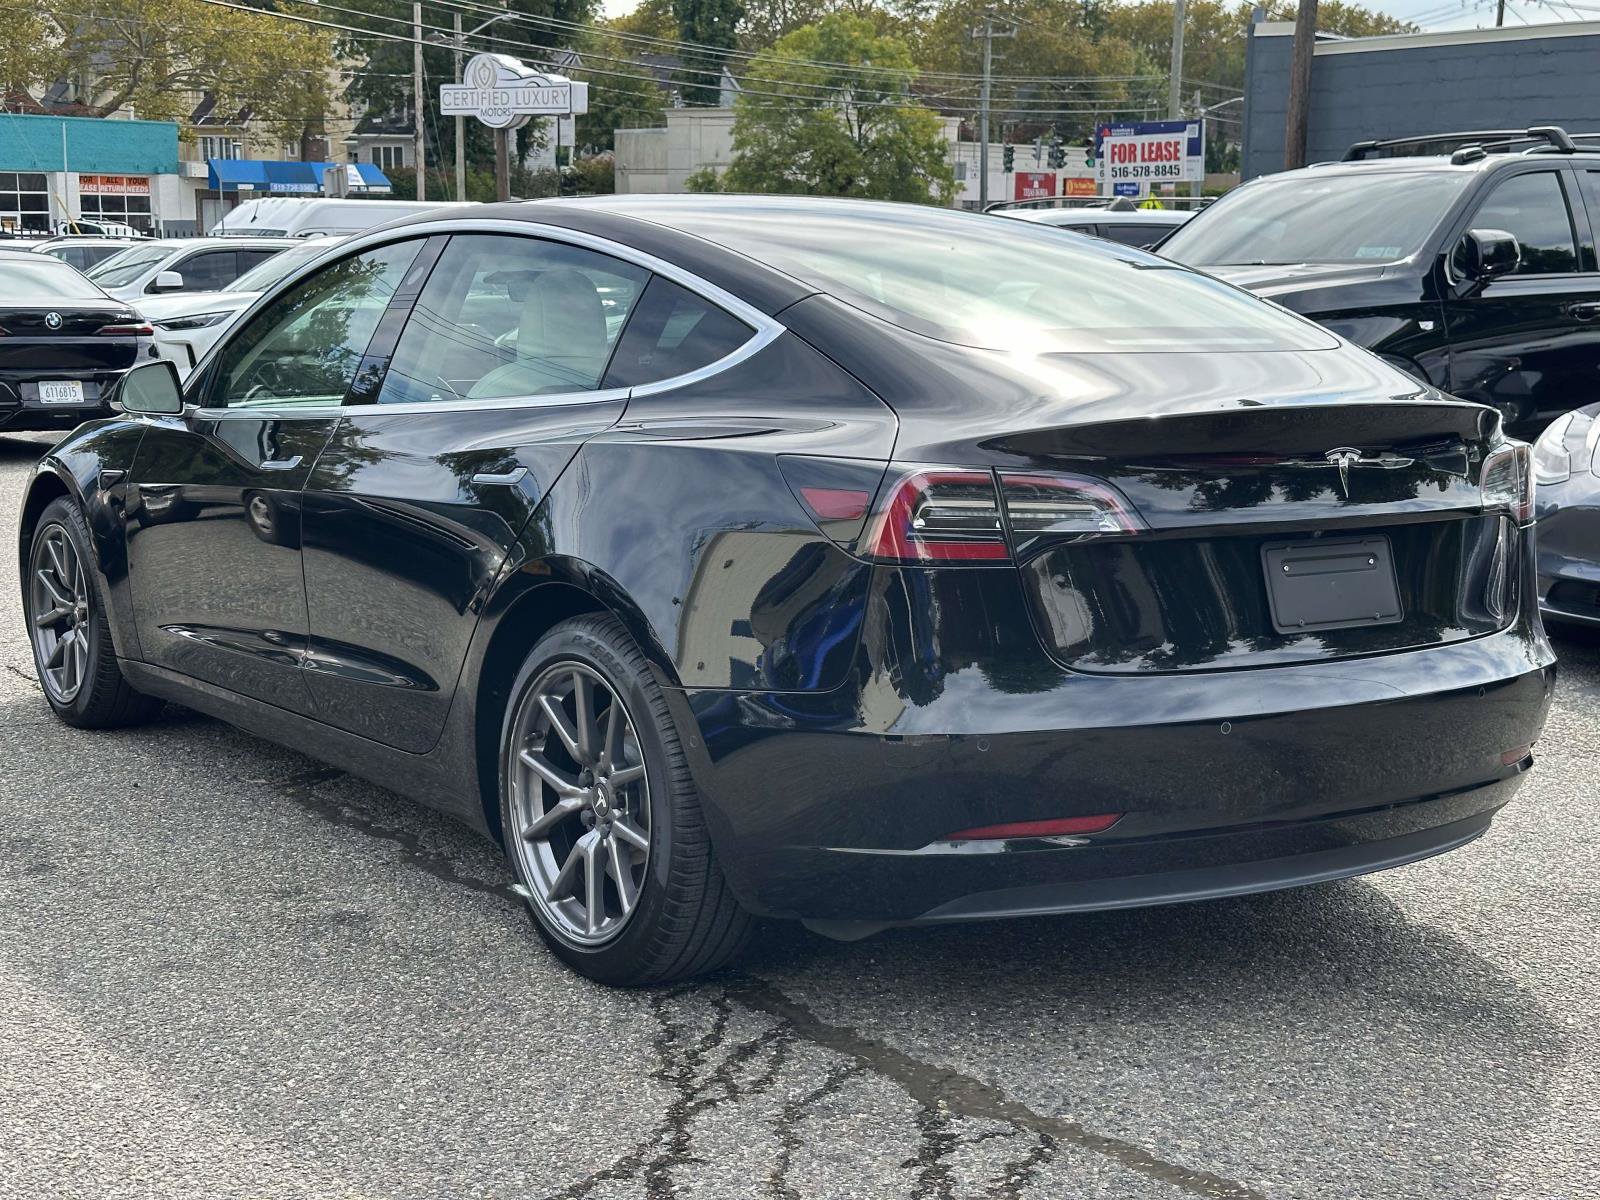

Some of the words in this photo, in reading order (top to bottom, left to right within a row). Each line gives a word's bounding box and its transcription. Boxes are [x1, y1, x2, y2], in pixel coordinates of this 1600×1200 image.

[442, 91, 510, 107] CERTIFIED
[515, 89, 569, 106] LUXURY
[480, 107, 512, 117] MOTORS
[1110, 143, 1137, 165] FOR
[1140, 141, 1181, 163] LEASE
[1111, 164, 1180, 178] 516-578-8845
[79, 176, 93, 184] FOR
[106, 176, 118, 184] ALL
[128, 177, 147, 185] YOUR
[79, 184, 98, 192] EASE
[100, 184, 125, 193] RETURN
[126, 185, 149, 193] NEEDS
[45, 386, 77, 398] 6116815
